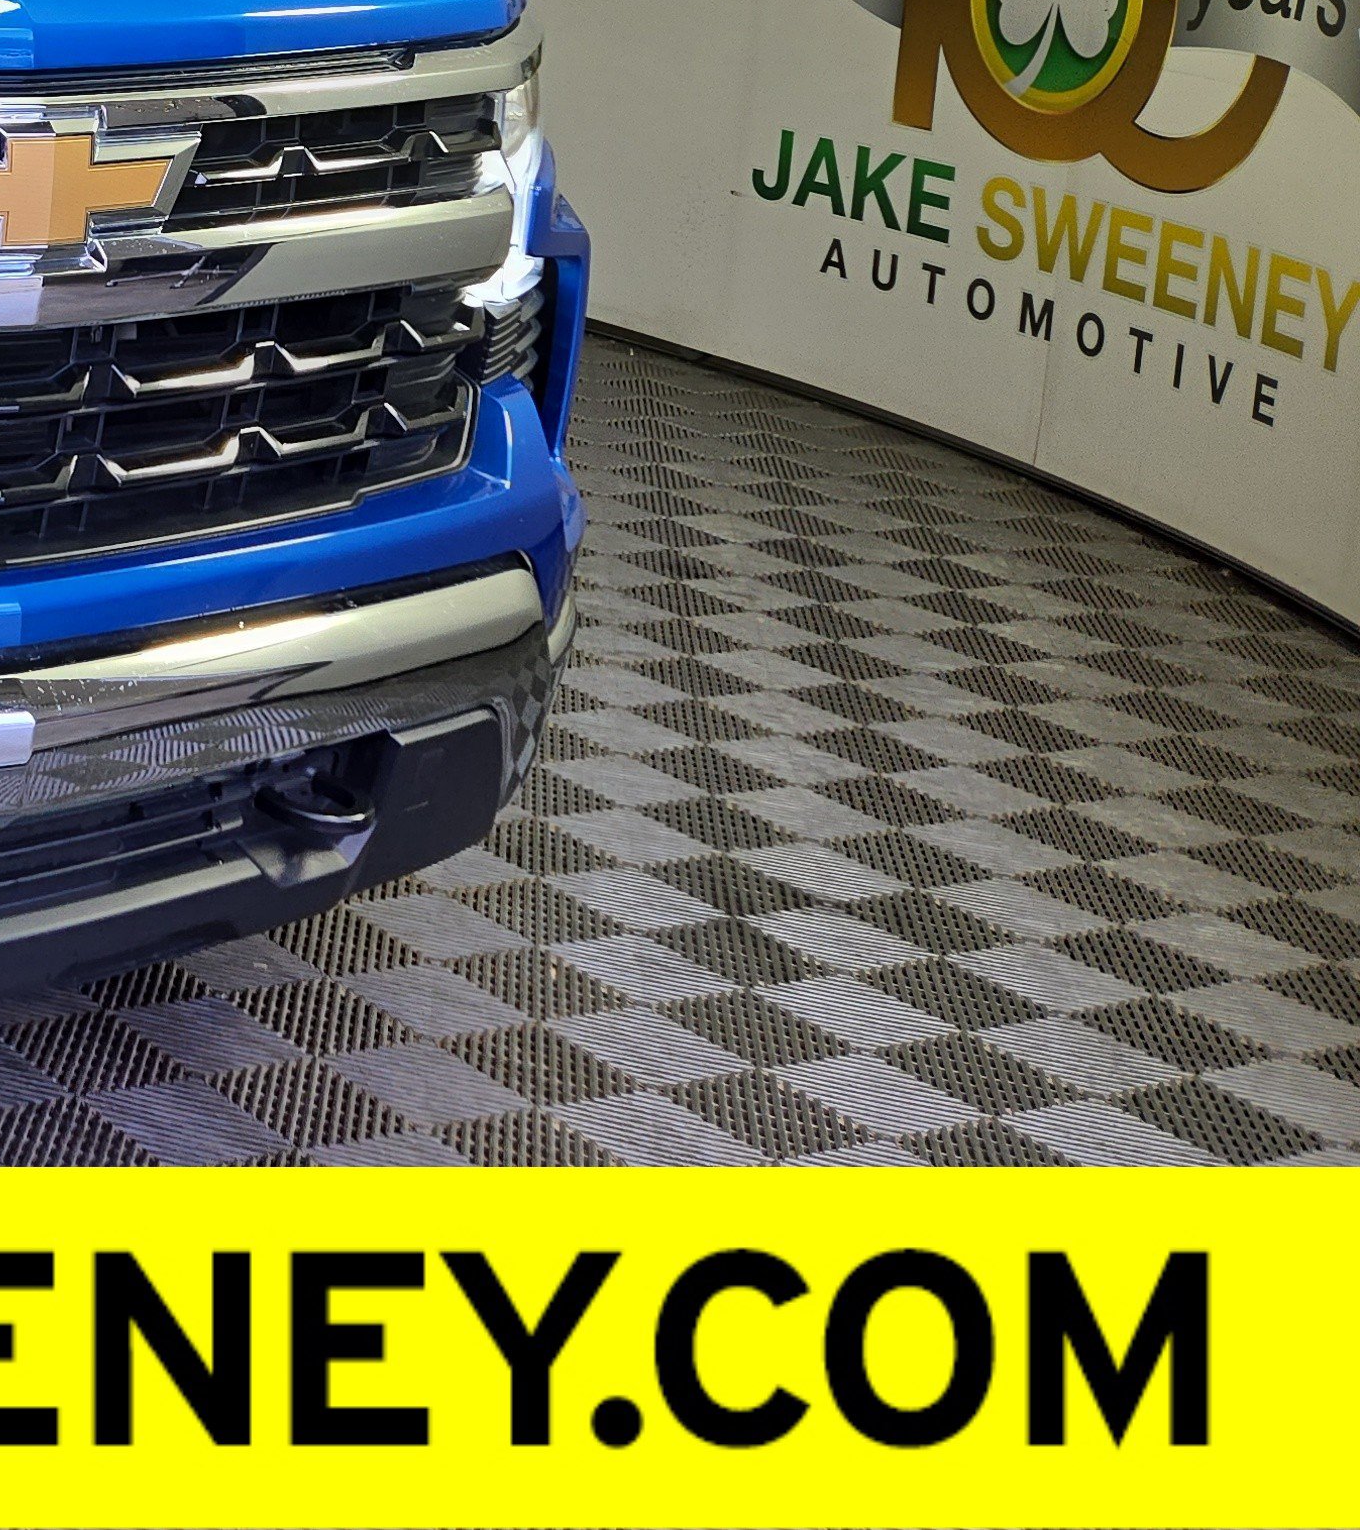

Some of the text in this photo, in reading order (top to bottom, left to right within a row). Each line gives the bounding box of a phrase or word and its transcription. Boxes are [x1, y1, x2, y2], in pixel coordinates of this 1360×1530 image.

[751, 129, 1360, 373] JAKE SWEENEY
[820, 237, 1278, 427] AUTOMOTIVE
